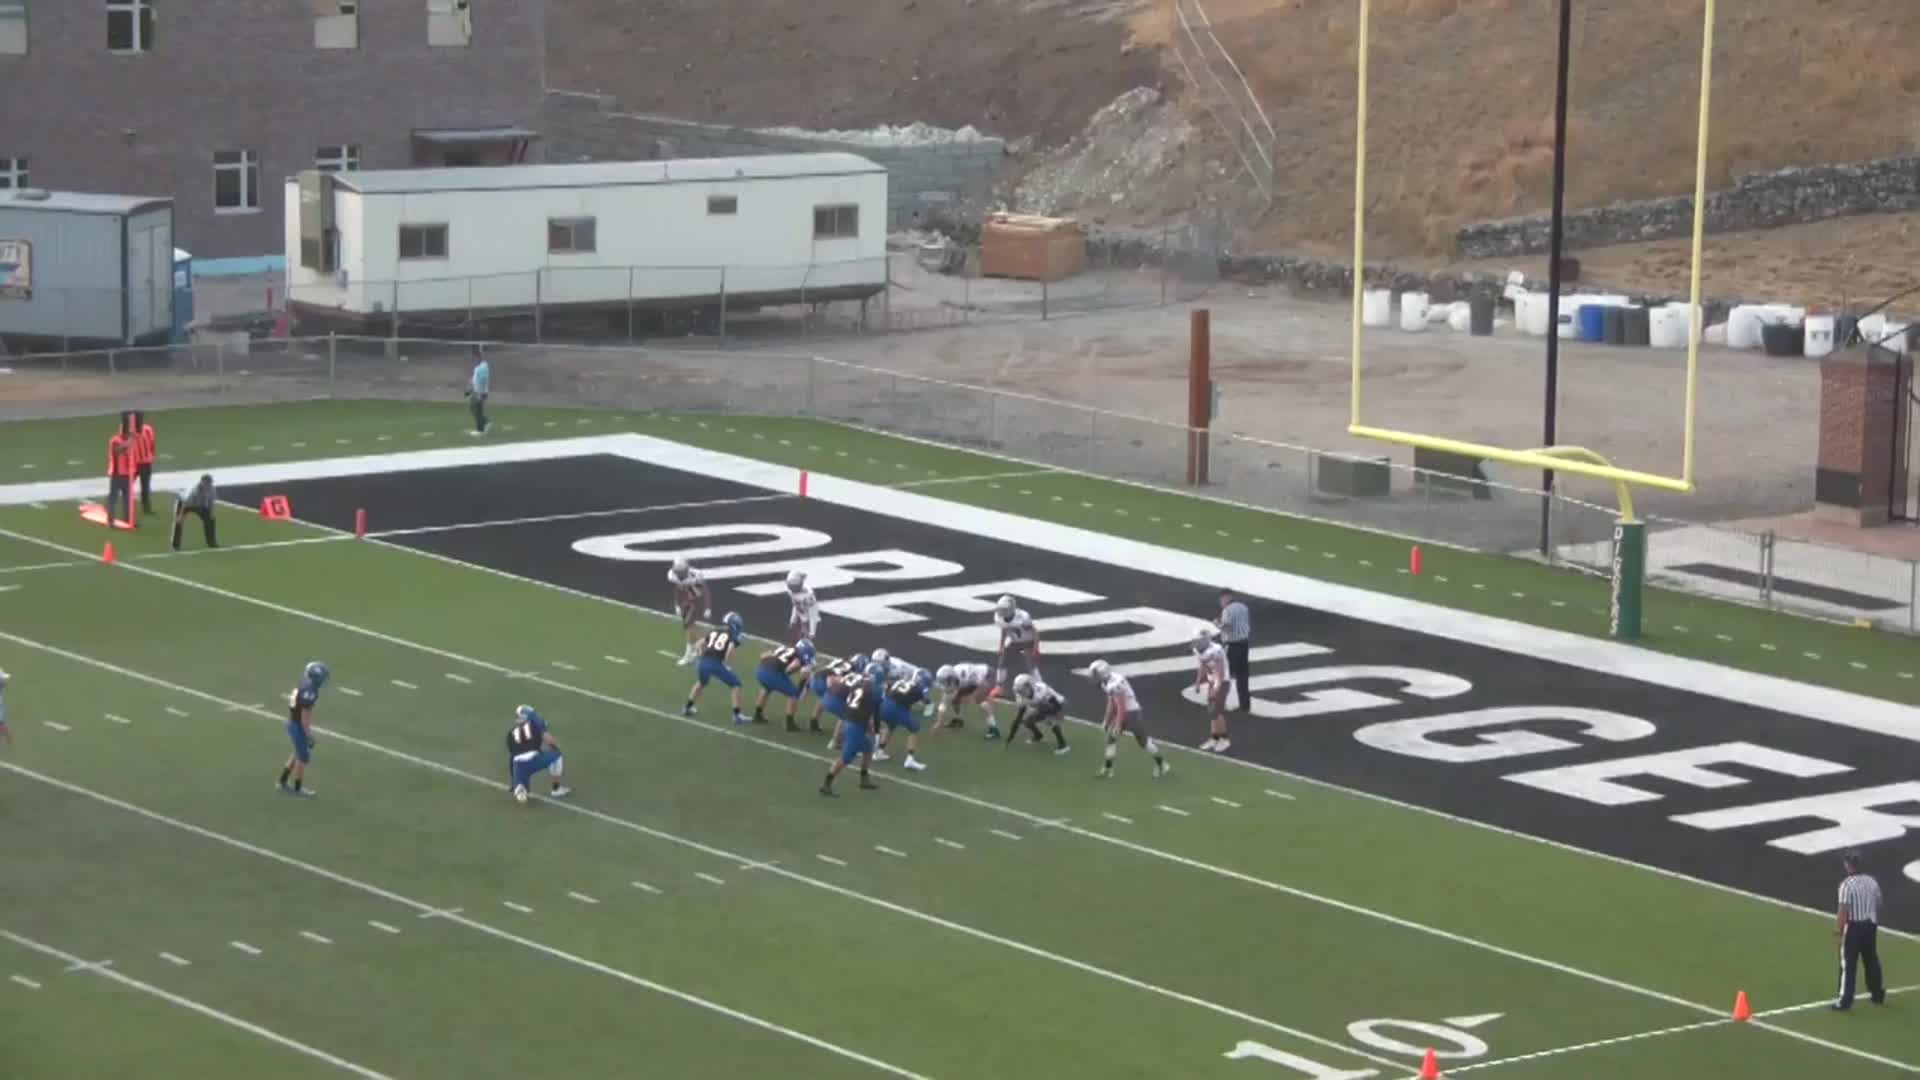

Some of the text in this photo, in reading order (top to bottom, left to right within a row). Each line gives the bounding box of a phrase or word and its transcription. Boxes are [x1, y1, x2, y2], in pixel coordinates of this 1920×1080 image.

[707, 631, 729, 650] 18
[571, 523, 1920, 883] OREDIGGER
[513, 723, 531, 743] 11
[1221, 1018, 1488, 1080] 10
